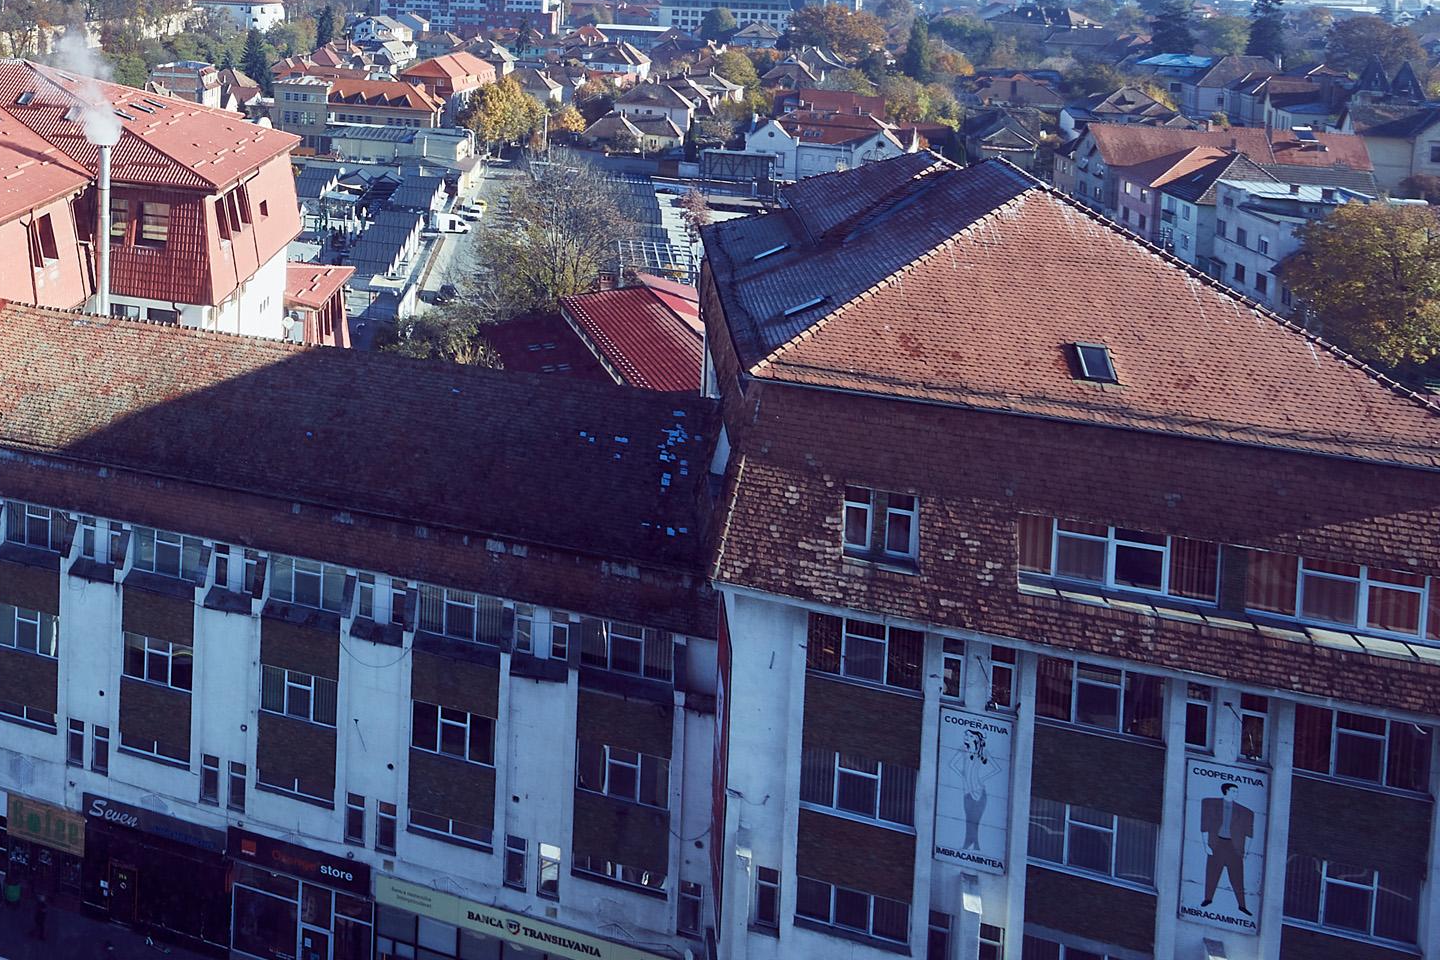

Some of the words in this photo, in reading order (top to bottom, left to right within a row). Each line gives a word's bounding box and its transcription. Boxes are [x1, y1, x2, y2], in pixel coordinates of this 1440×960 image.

[944, 715, 1009, 735] COOPERATIVA
[1192, 767, 1264, 787] COOPERATIVA
[88, 799, 138, 828] Seven
[936, 846, 1004, 869] IMBRACAMINTEA
[320, 864, 353, 881] store
[1181, 906, 1257, 929] IMBRACAMINTEA
[467, 910, 504, 929] BANCA
[522, 926, 601, 957] TRANSILVANIA
